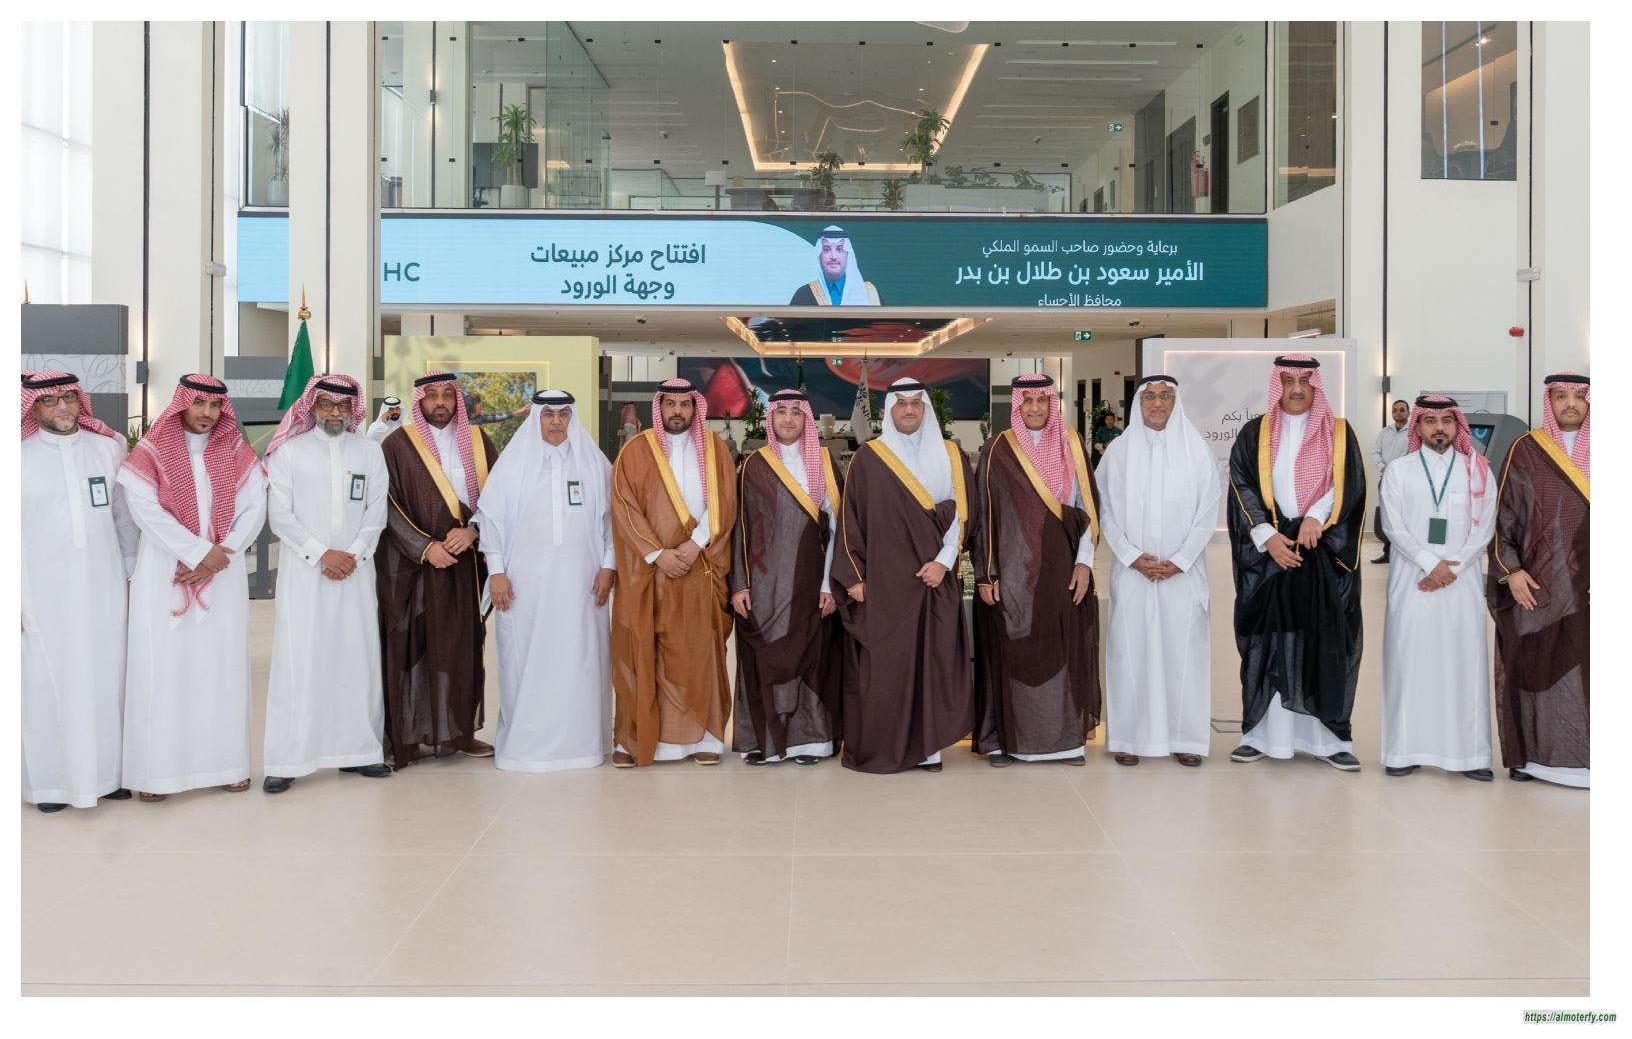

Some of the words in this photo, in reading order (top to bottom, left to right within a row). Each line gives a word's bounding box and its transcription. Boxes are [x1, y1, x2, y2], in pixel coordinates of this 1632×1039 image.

[531, 243, 598, 268] مبيعات
[606, 244, 643, 268] مركز
[983, 240, 1018, 257] الملكي
[1024, 241, 1057, 255] السمو
[1062, 241, 1098, 254] صاحب
[1102, 242, 1143, 255] وحضور
[1147, 241, 1177, 255] برعاية
[651, 243, 705, 271] افتتاح
[384, 263, 420, 281] HC
[956, 266, 981, 284] بدر
[989, 264, 1009, 284] بن
[1017, 262, 1061, 284] طلال
[1069, 265, 1089, 285] بن
[1097, 267, 1149, 285] سعود
[1156, 260, 1203, 285] الأمير
[561, 275, 616, 299] الورود
[624, 273, 674, 300] وجهة
[1039, 293, 1079, 306] الأحساء
[1084, 294, 1121, 306] محافظ
